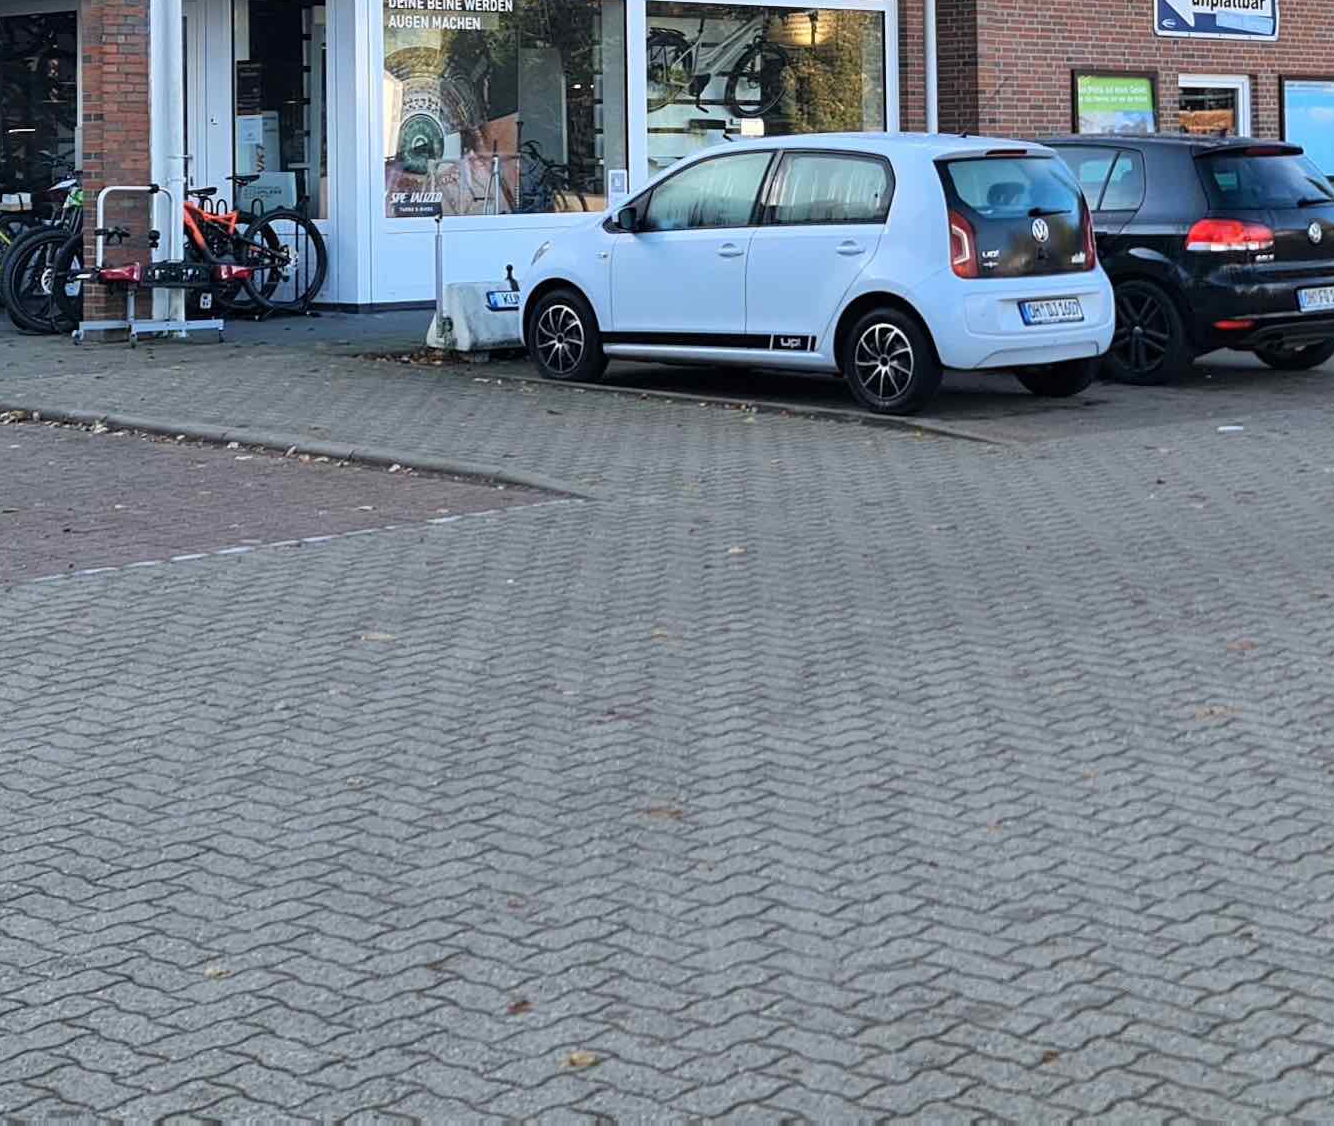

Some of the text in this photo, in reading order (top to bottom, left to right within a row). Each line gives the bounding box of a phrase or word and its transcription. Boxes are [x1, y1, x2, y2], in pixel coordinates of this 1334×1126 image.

[388, 15, 481, 30] AUGEN MACHEN
[390, 192, 443, 203] SPEIALIZED
